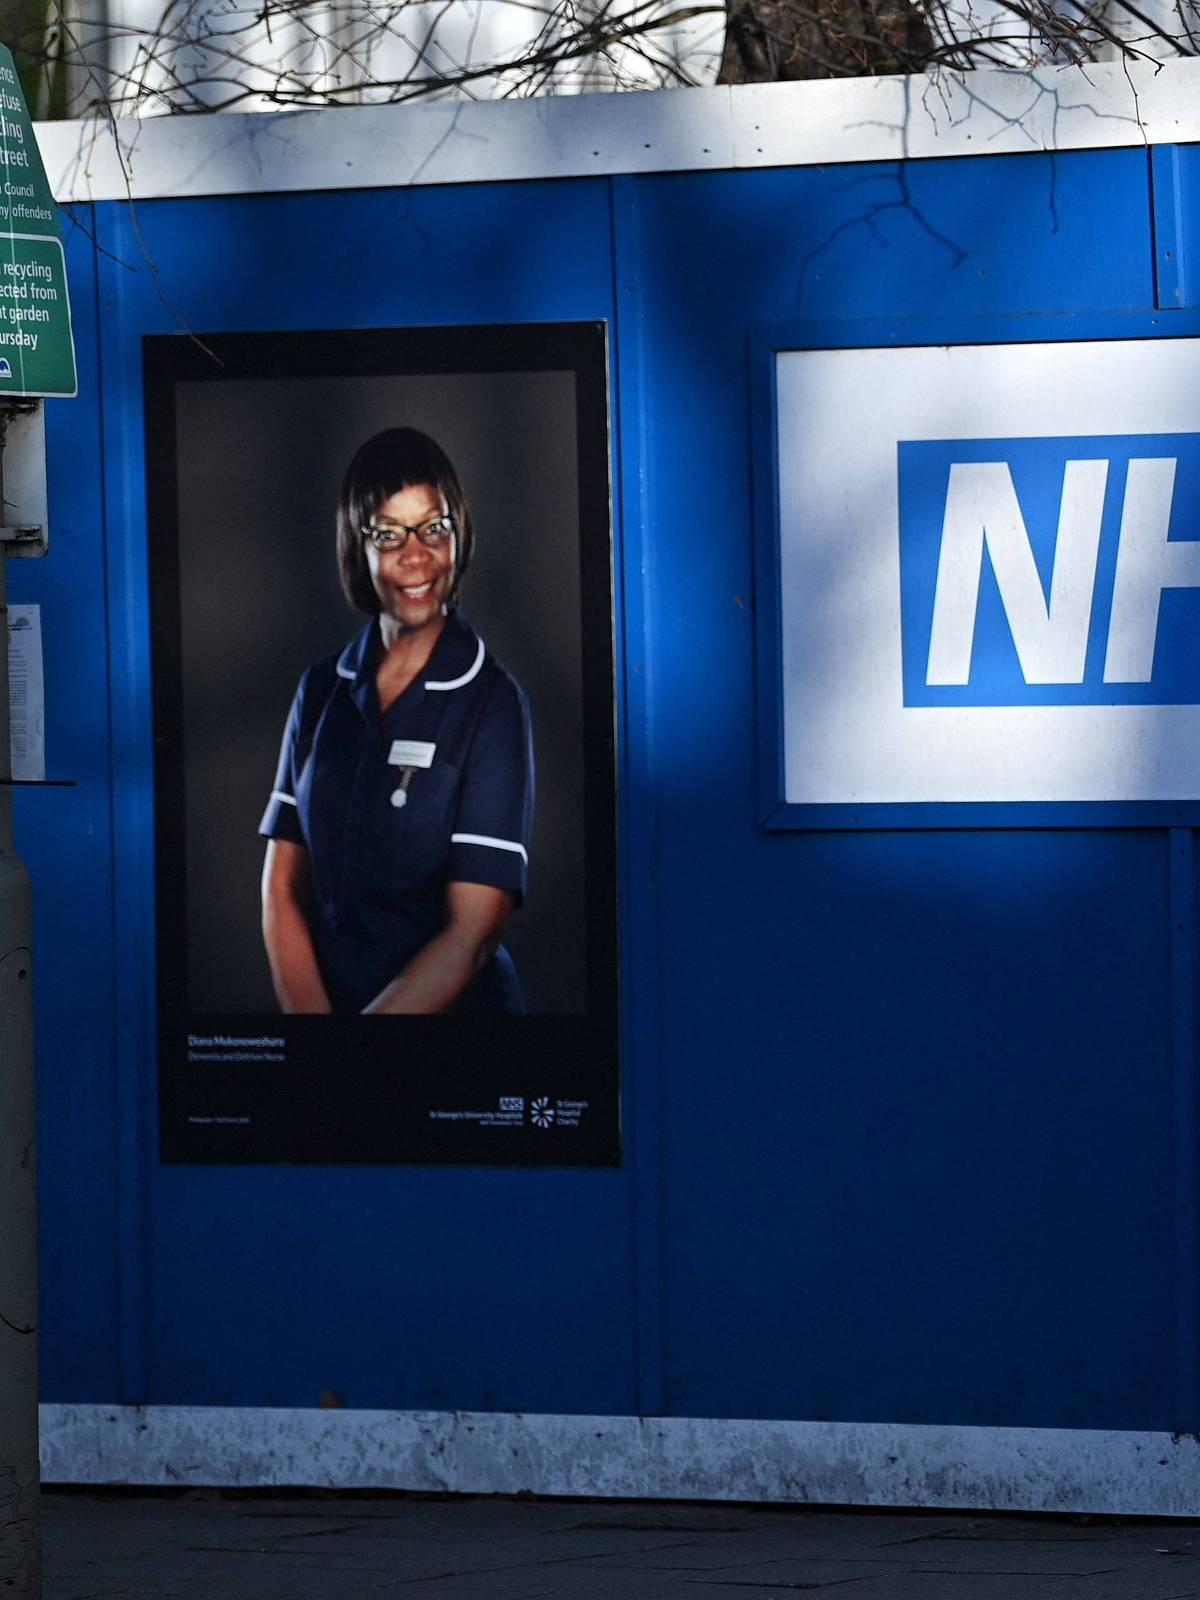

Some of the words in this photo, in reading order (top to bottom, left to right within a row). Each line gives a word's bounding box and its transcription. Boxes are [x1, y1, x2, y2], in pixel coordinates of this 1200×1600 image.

[4, 182, 35, 197] Council
[12, 203, 52, 220] offenders
[3, 260, 52, 282] recycling
[30, 282, 57, 300] from
[9, 304, 50, 324] garden
